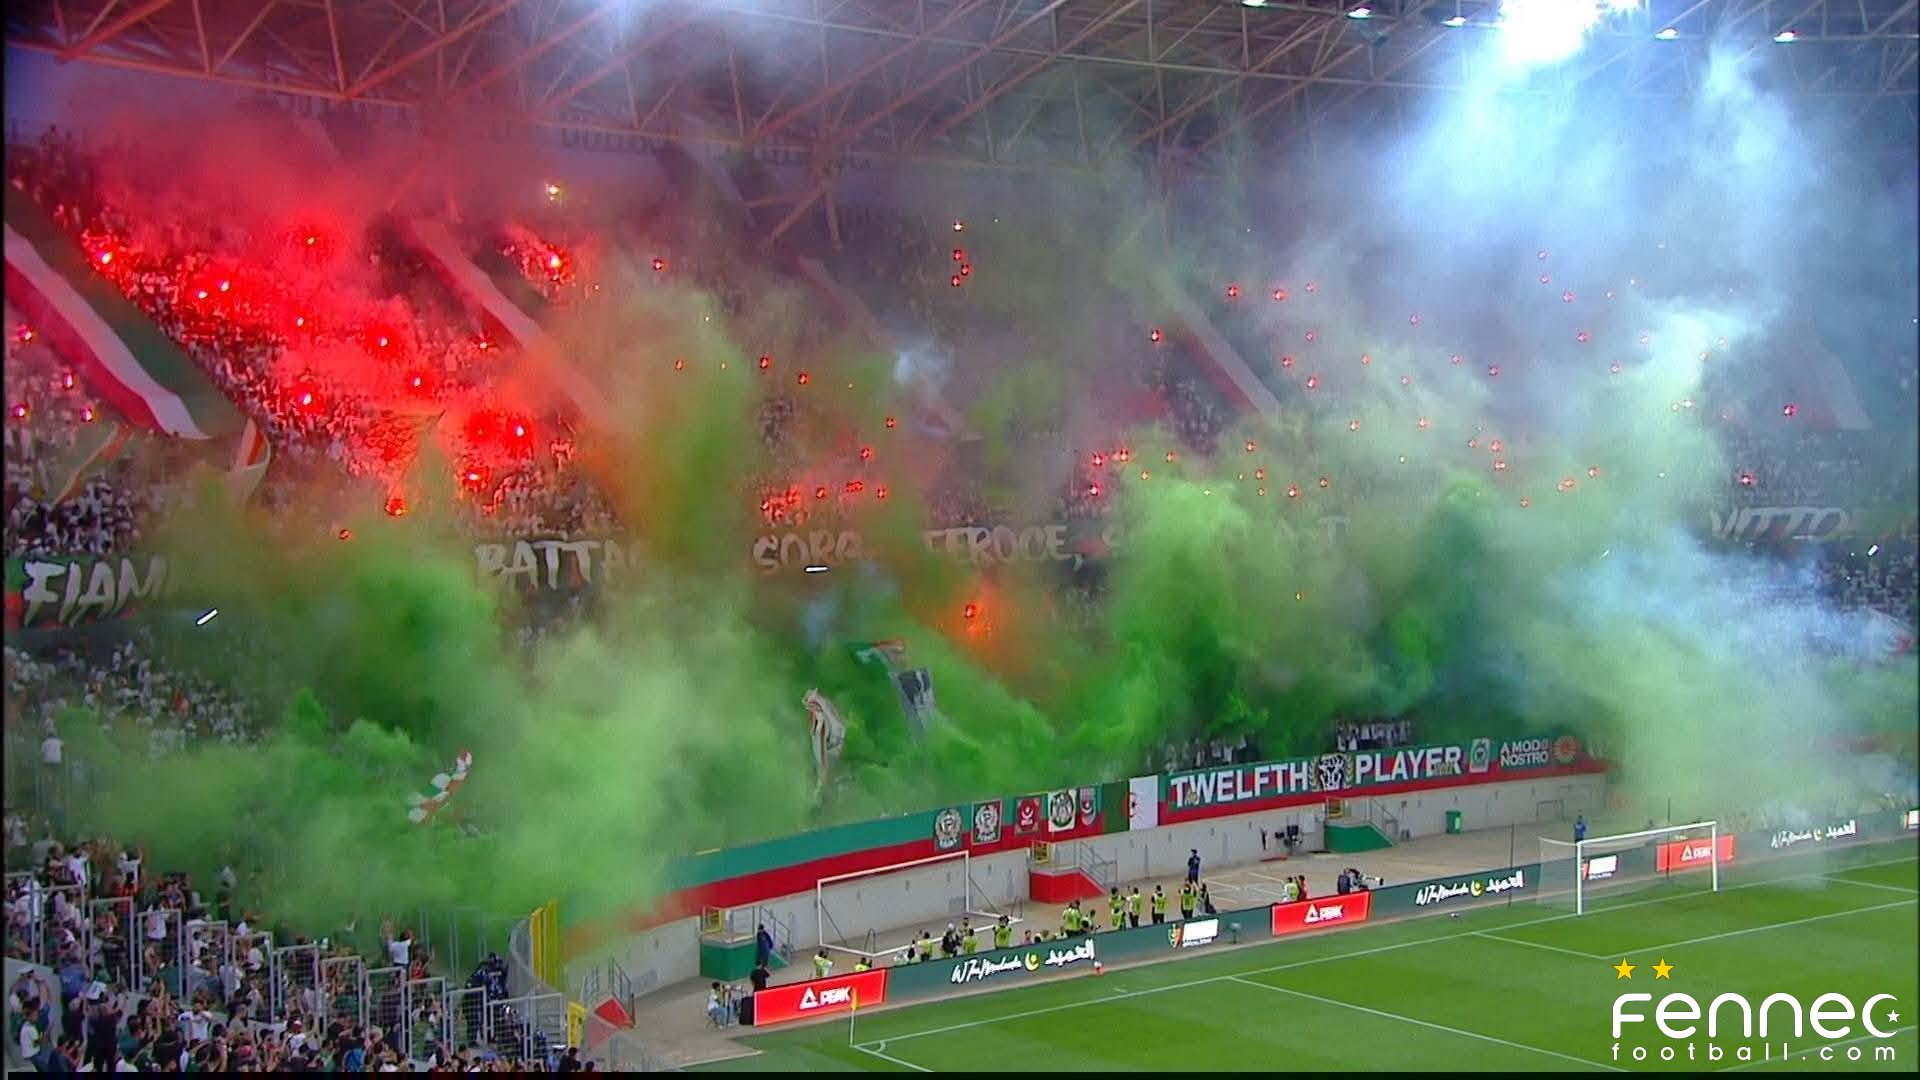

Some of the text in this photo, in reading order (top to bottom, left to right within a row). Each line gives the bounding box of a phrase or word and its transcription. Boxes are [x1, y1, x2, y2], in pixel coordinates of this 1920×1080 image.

[1711, 506, 1854, 541] VITTO
[1500, 751, 1549, 767] NOSTRO
[1170, 747, 1462, 808] TWELFTH PLAYER
[820, 986, 852, 1006] PEAK
